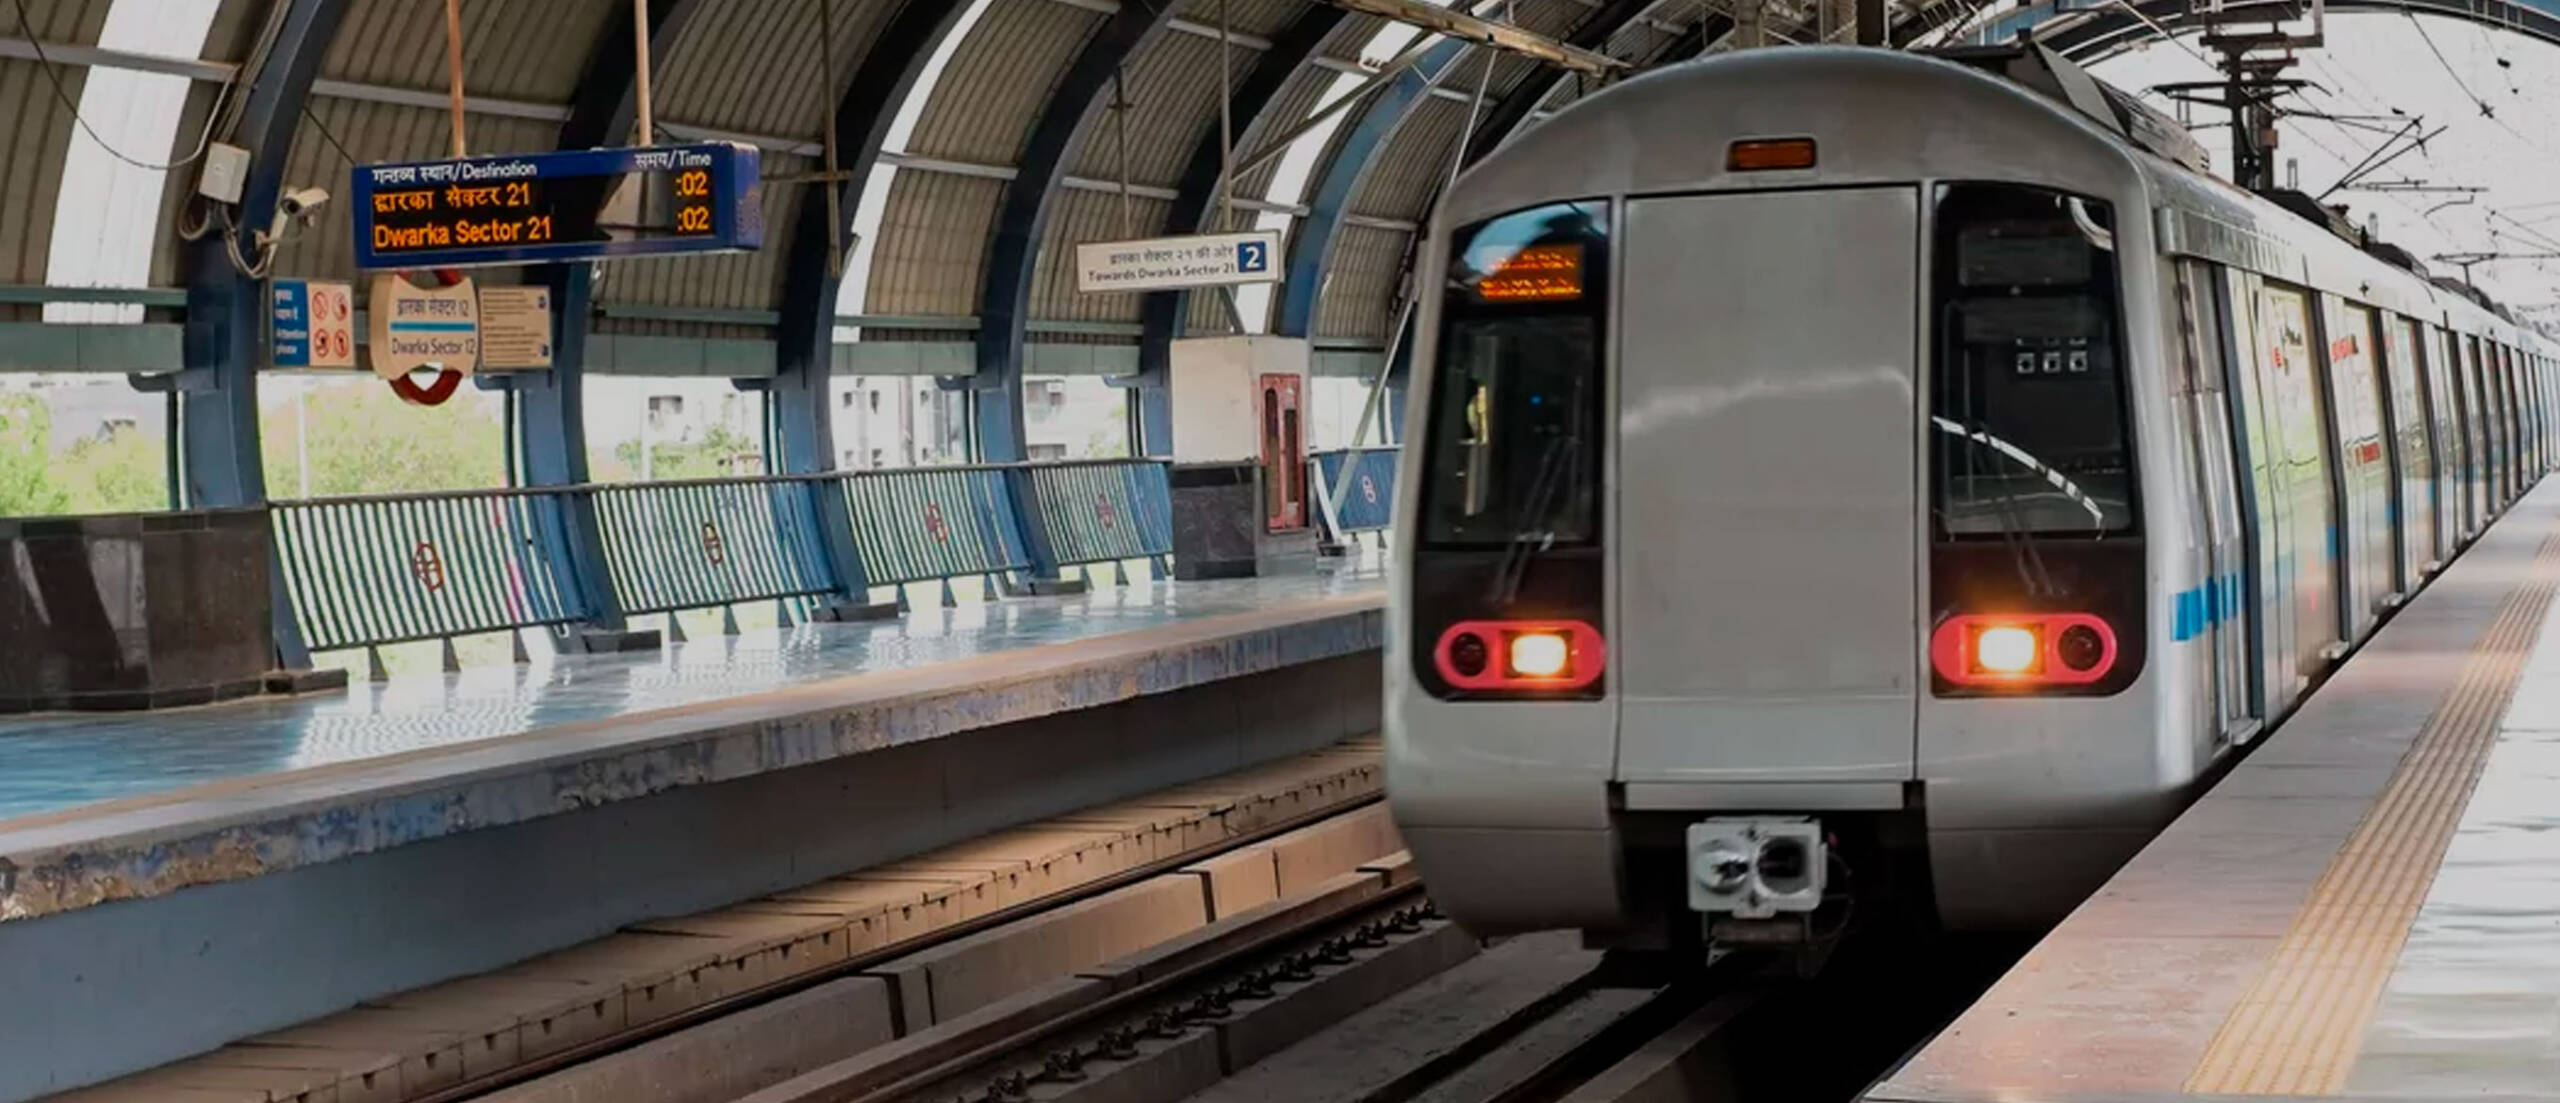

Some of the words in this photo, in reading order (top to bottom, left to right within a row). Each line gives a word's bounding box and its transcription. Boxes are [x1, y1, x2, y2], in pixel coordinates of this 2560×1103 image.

[676, 172, 708, 195] :02
[374, 192, 434, 212] द्वारका
[506, 182, 530, 206] 21
[677, 207, 709, 231] :02
[374, 223, 450, 248] Dwarka
[456, 219, 521, 243] Sector
[528, 216, 551, 239] 21
[1245, 246, 1261, 269] 2
[1088, 269, 1136, 281] Towards
[1138, 264, 1181, 279] Dwarka
[1182, 264, 1220, 276] Sector
[458, 299, 469, 317] 12
[391, 337, 429, 355] Dwarka
[430, 337, 464, 355] Sector
[464, 338, 476, 355] 12
